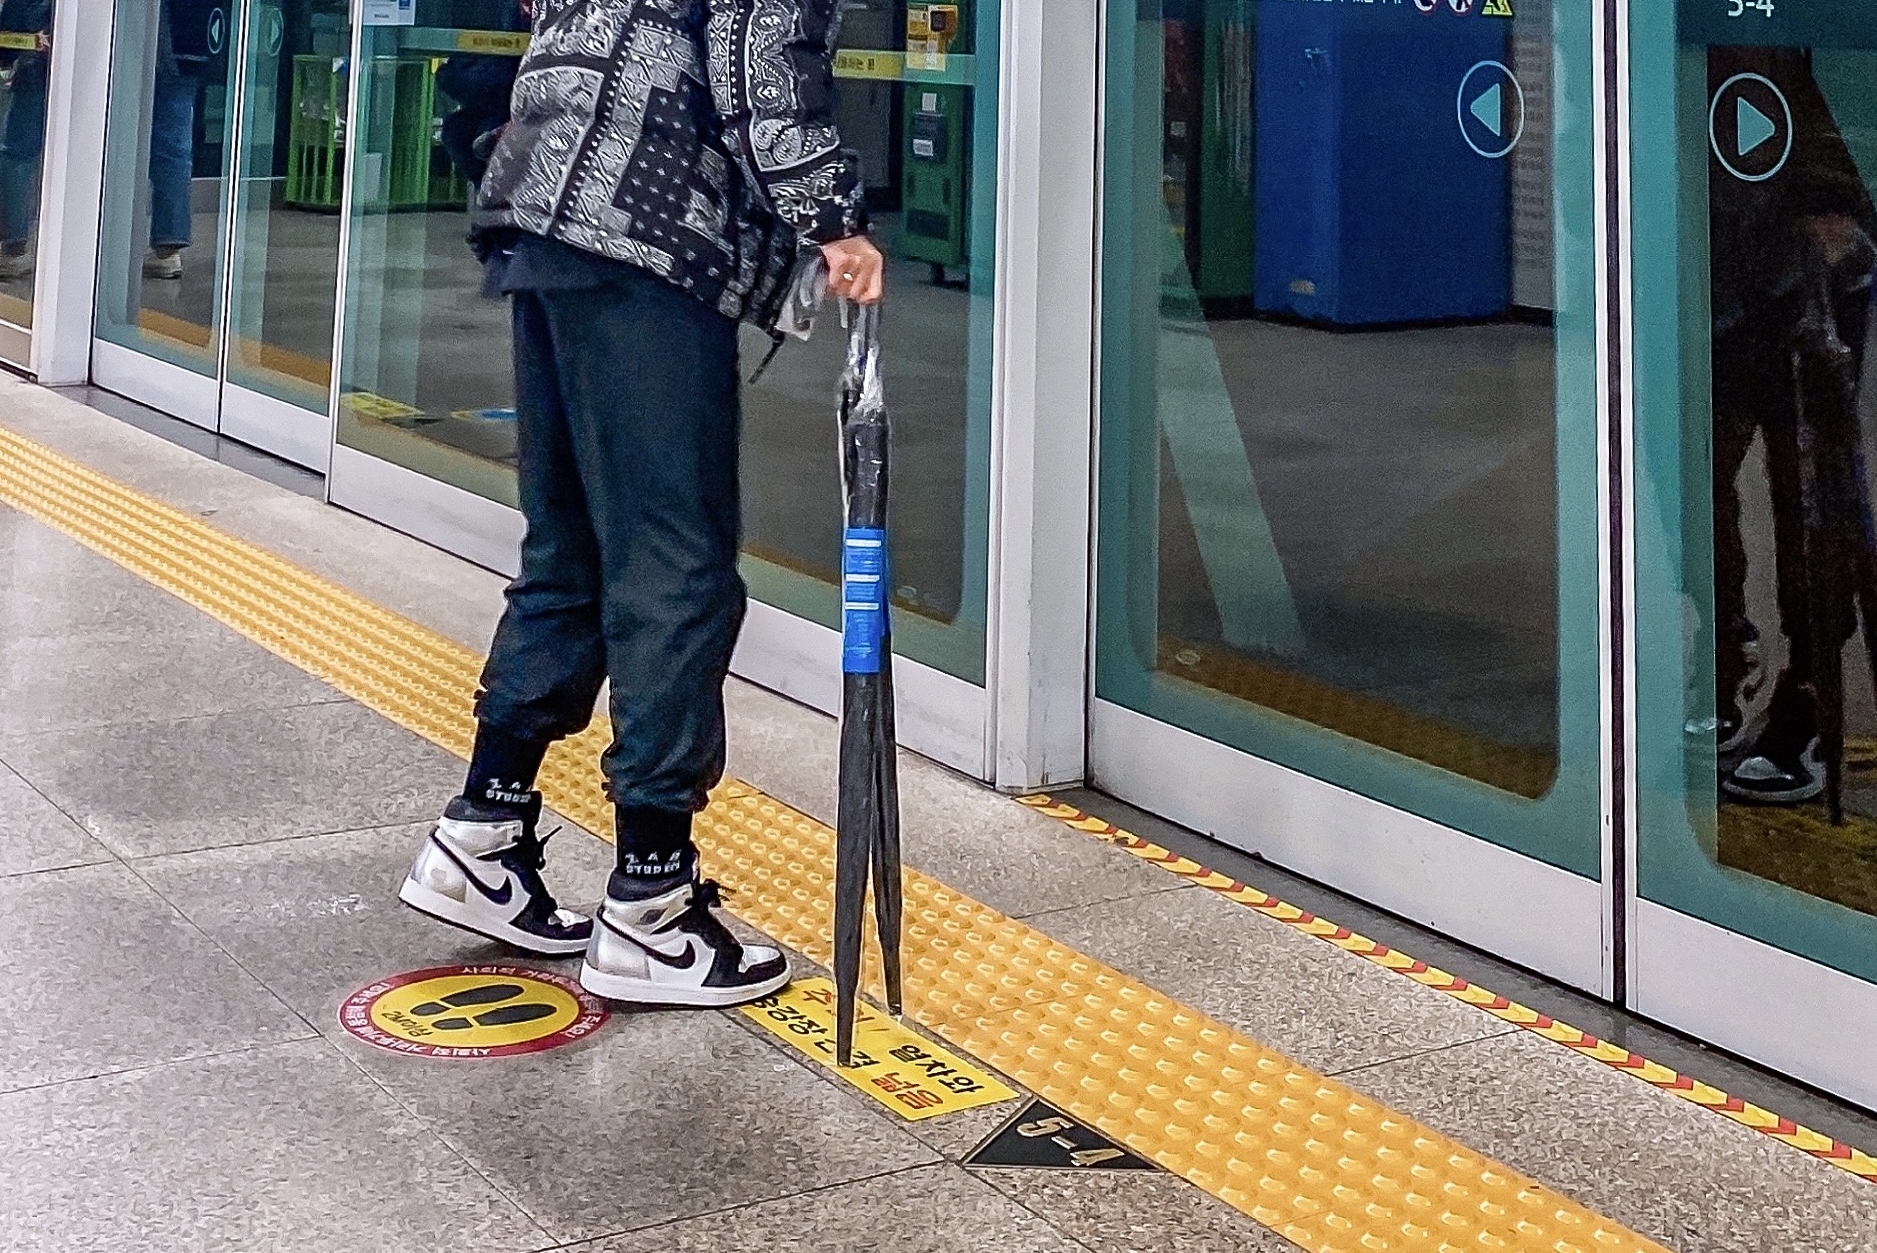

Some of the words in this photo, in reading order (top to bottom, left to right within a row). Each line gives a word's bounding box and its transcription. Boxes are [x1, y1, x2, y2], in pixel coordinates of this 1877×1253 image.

[870, 1071, 944, 1110] 넓음
[888, 1044, 984, 1095] 열차와
[1016, 1116, 1126, 1167] 5-4
